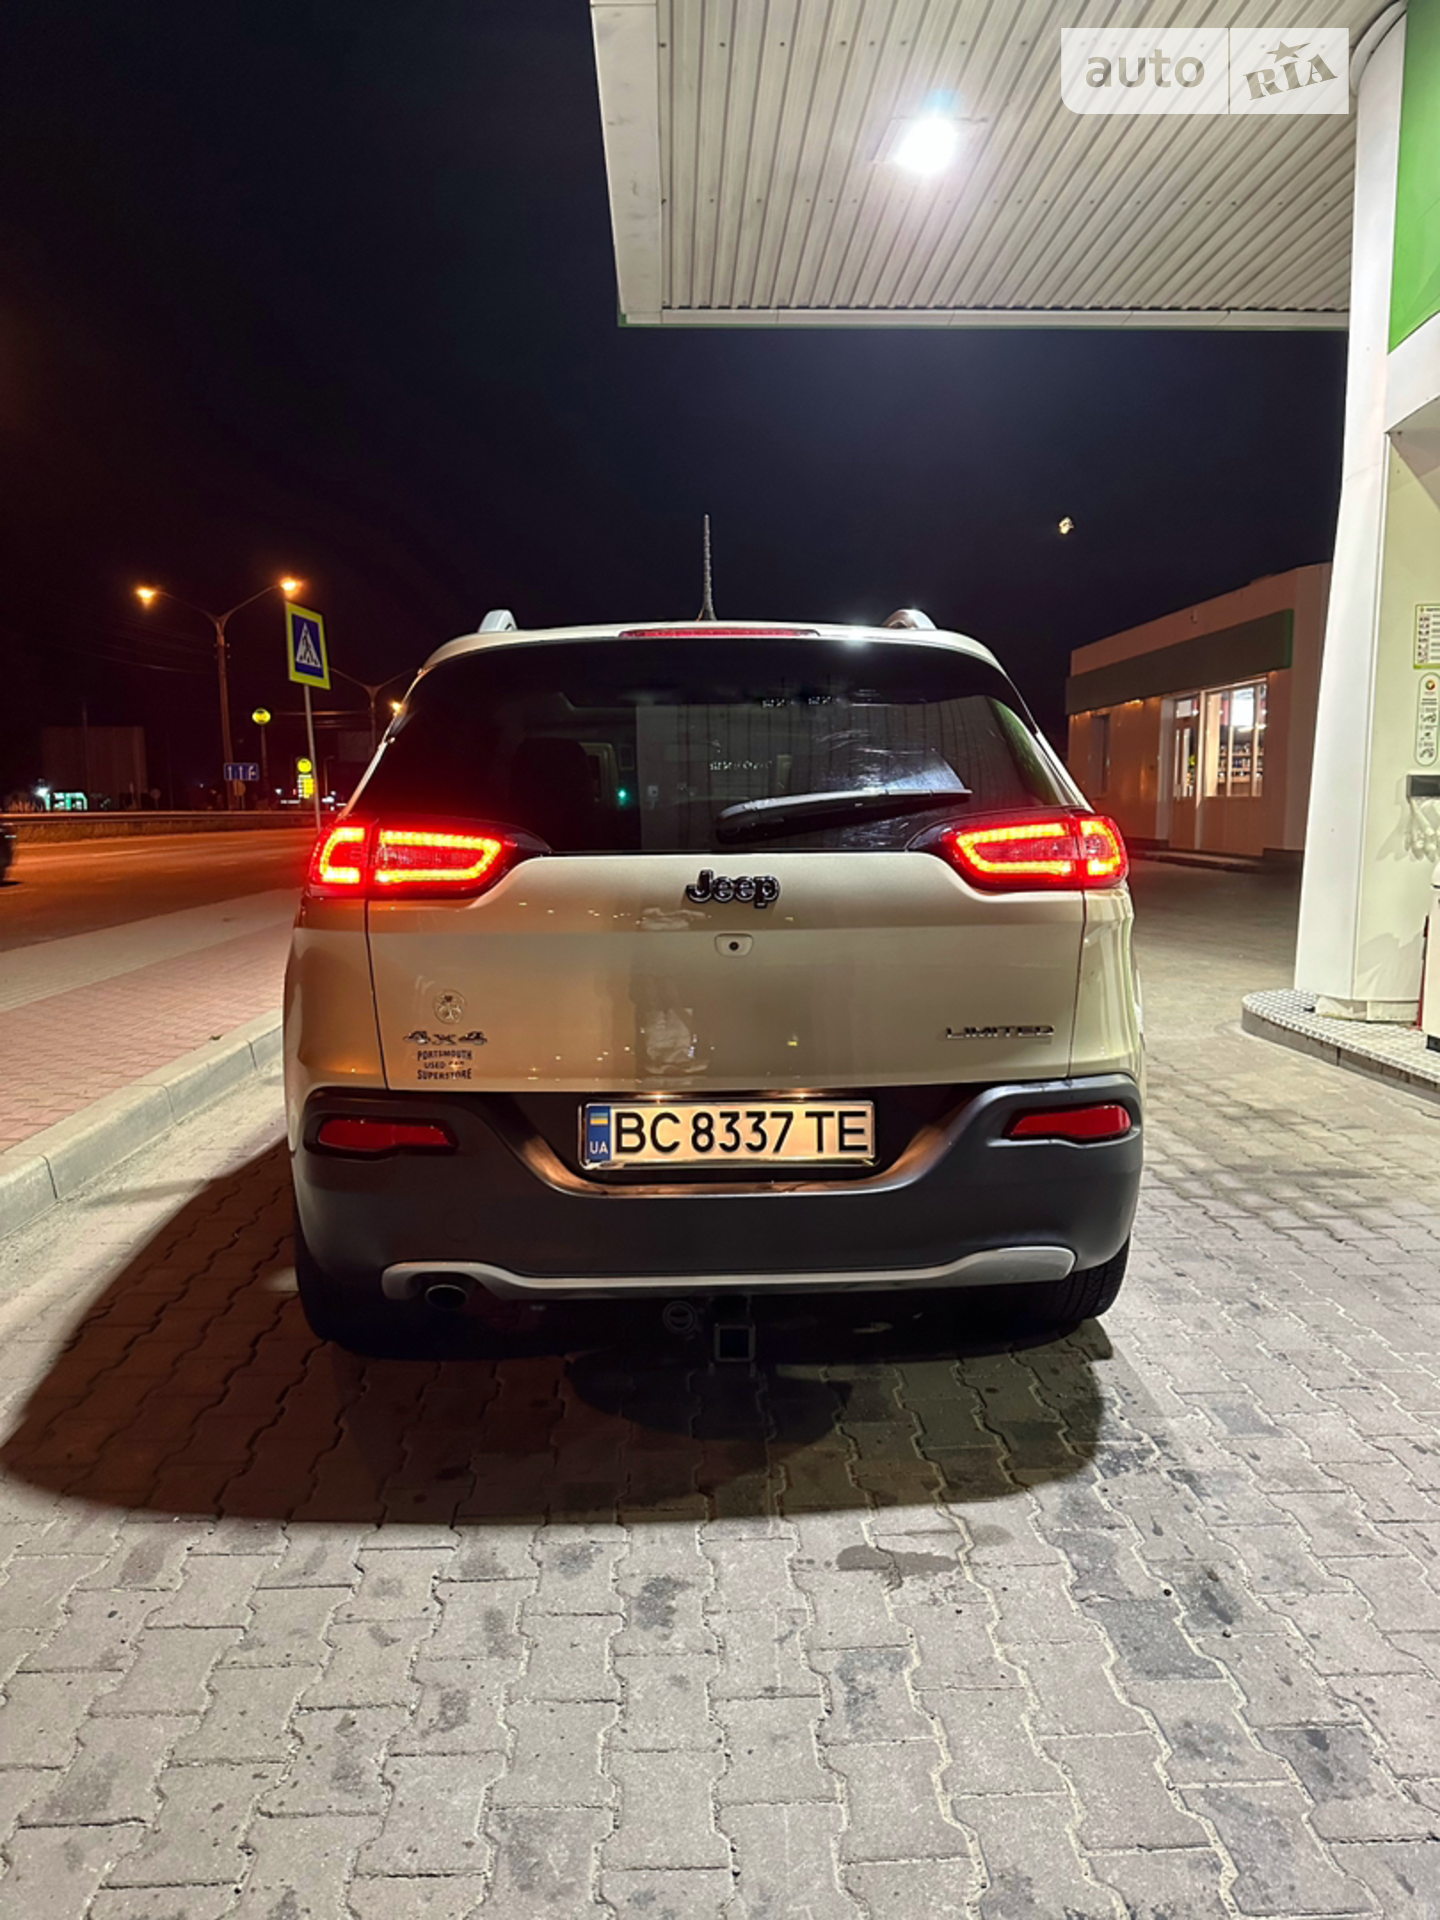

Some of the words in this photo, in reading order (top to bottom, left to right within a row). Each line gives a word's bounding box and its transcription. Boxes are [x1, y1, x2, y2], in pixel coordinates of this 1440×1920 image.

[685, 869, 780, 909] Jeep
[946, 1025, 1055, 1039] LIMITED
[417, 1049, 473, 1062] PORTSMOUTH
[417, 1068, 472, 1080] SUPERSTORE
[615, 1111, 681, 1153] BC
[691, 1111, 795, 1153] 8337
[805, 1110, 869, 1153] TE
[589, 1140, 609, 1155] UA
